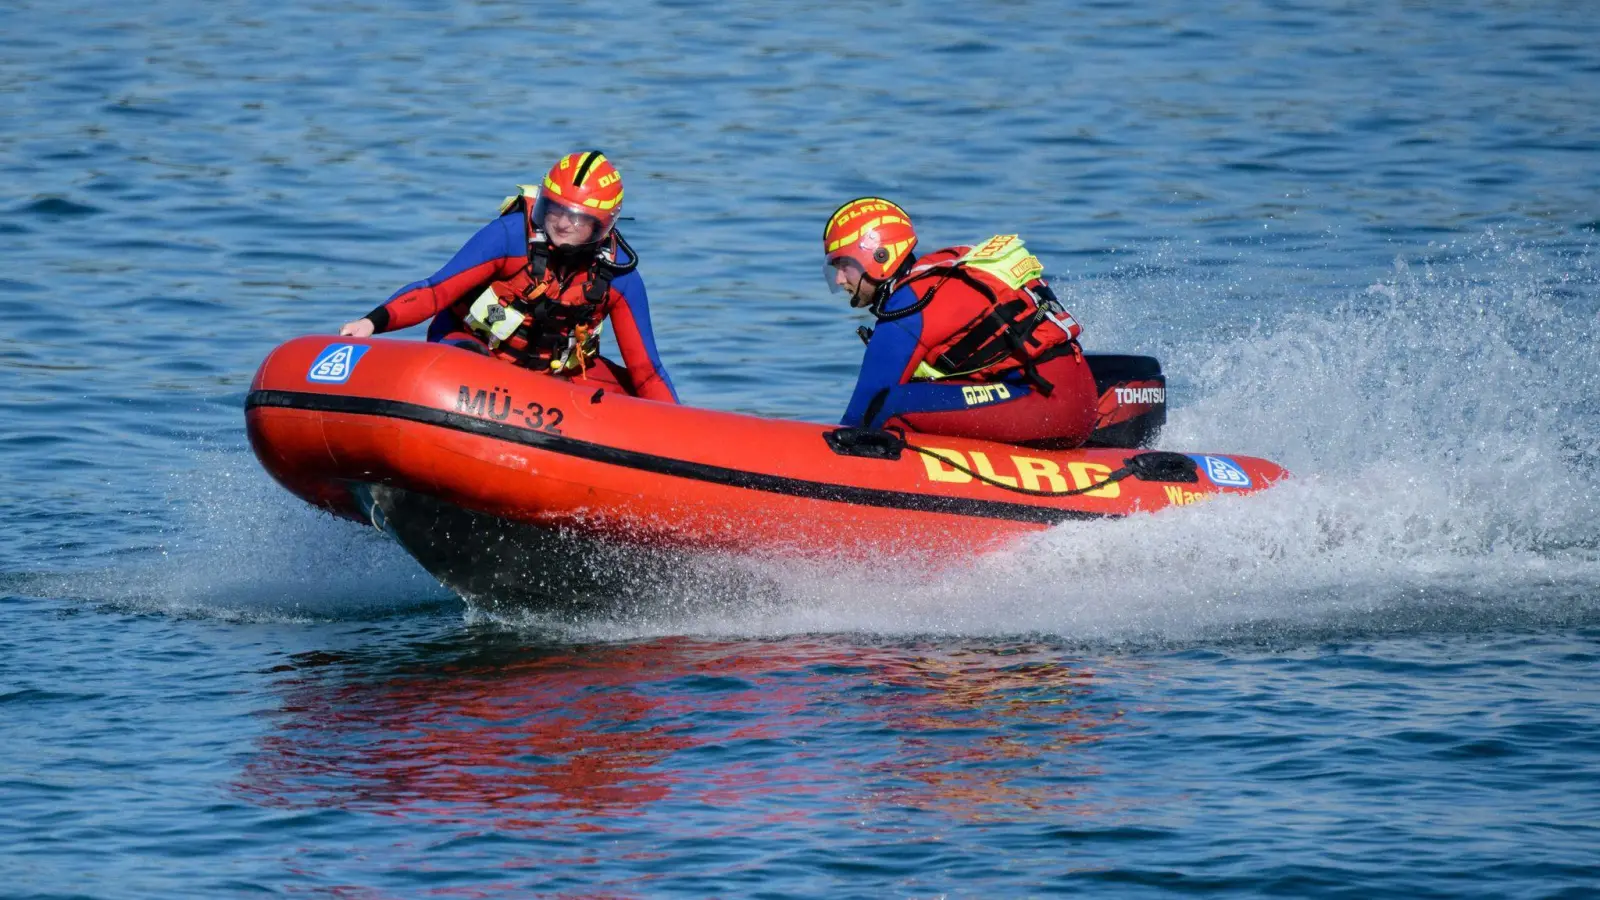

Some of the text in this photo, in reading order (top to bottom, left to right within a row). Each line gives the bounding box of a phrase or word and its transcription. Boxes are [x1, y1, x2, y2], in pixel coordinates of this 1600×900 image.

[837, 204, 889, 228] DLRG
[456, 384, 564, 435] MÜ-32
[1115, 387, 1165, 404] TOHATSU
[920, 446, 1121, 499] DLRG
